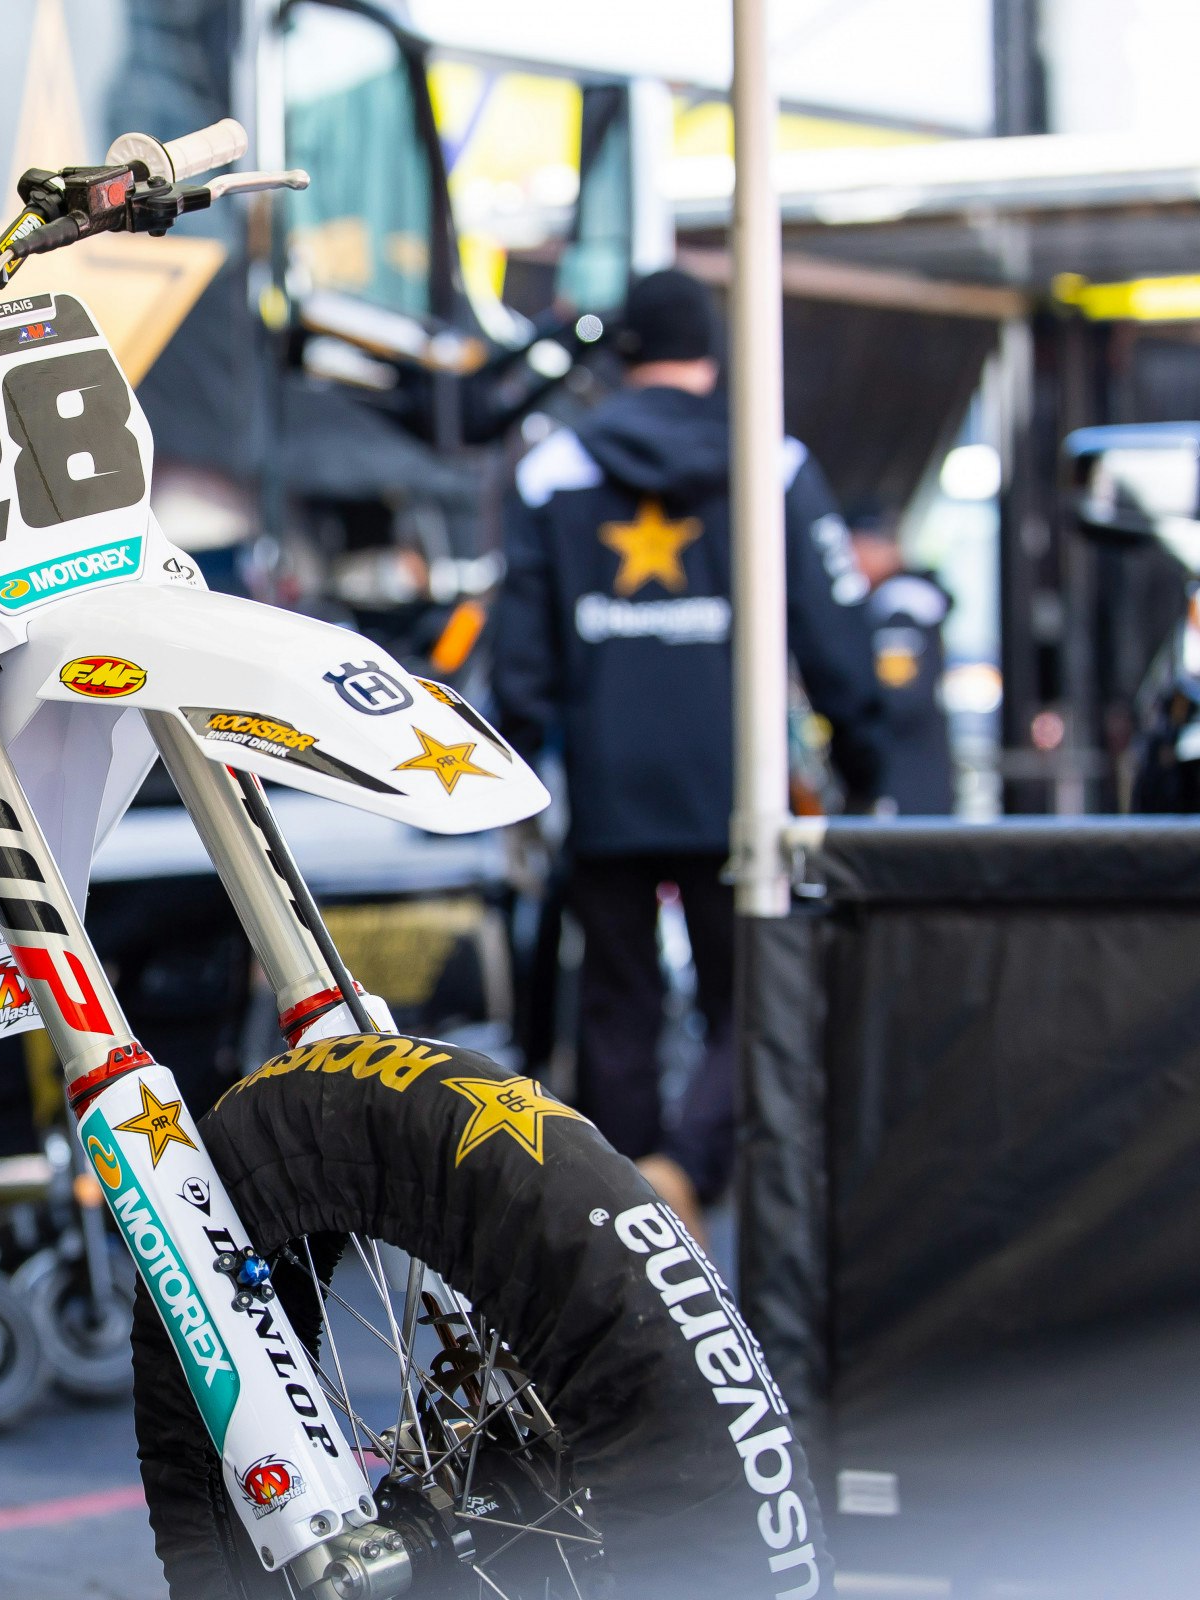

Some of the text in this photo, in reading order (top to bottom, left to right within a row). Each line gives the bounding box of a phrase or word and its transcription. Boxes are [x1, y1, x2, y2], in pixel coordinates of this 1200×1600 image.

[18, 321, 58, 343] AMA
[30, 546, 134, 593] MOTOREX
[59, 661, 148, 689] FMF
[205, 713, 316, 752] ROCKSTAR
[205, 730, 290, 758] ENERGY DRINK
[113, 1186, 233, 1388] MOTOREX
[202, 1226, 338, 1458] DNLOP
[614, 1202, 821, 1600] usqvarna
